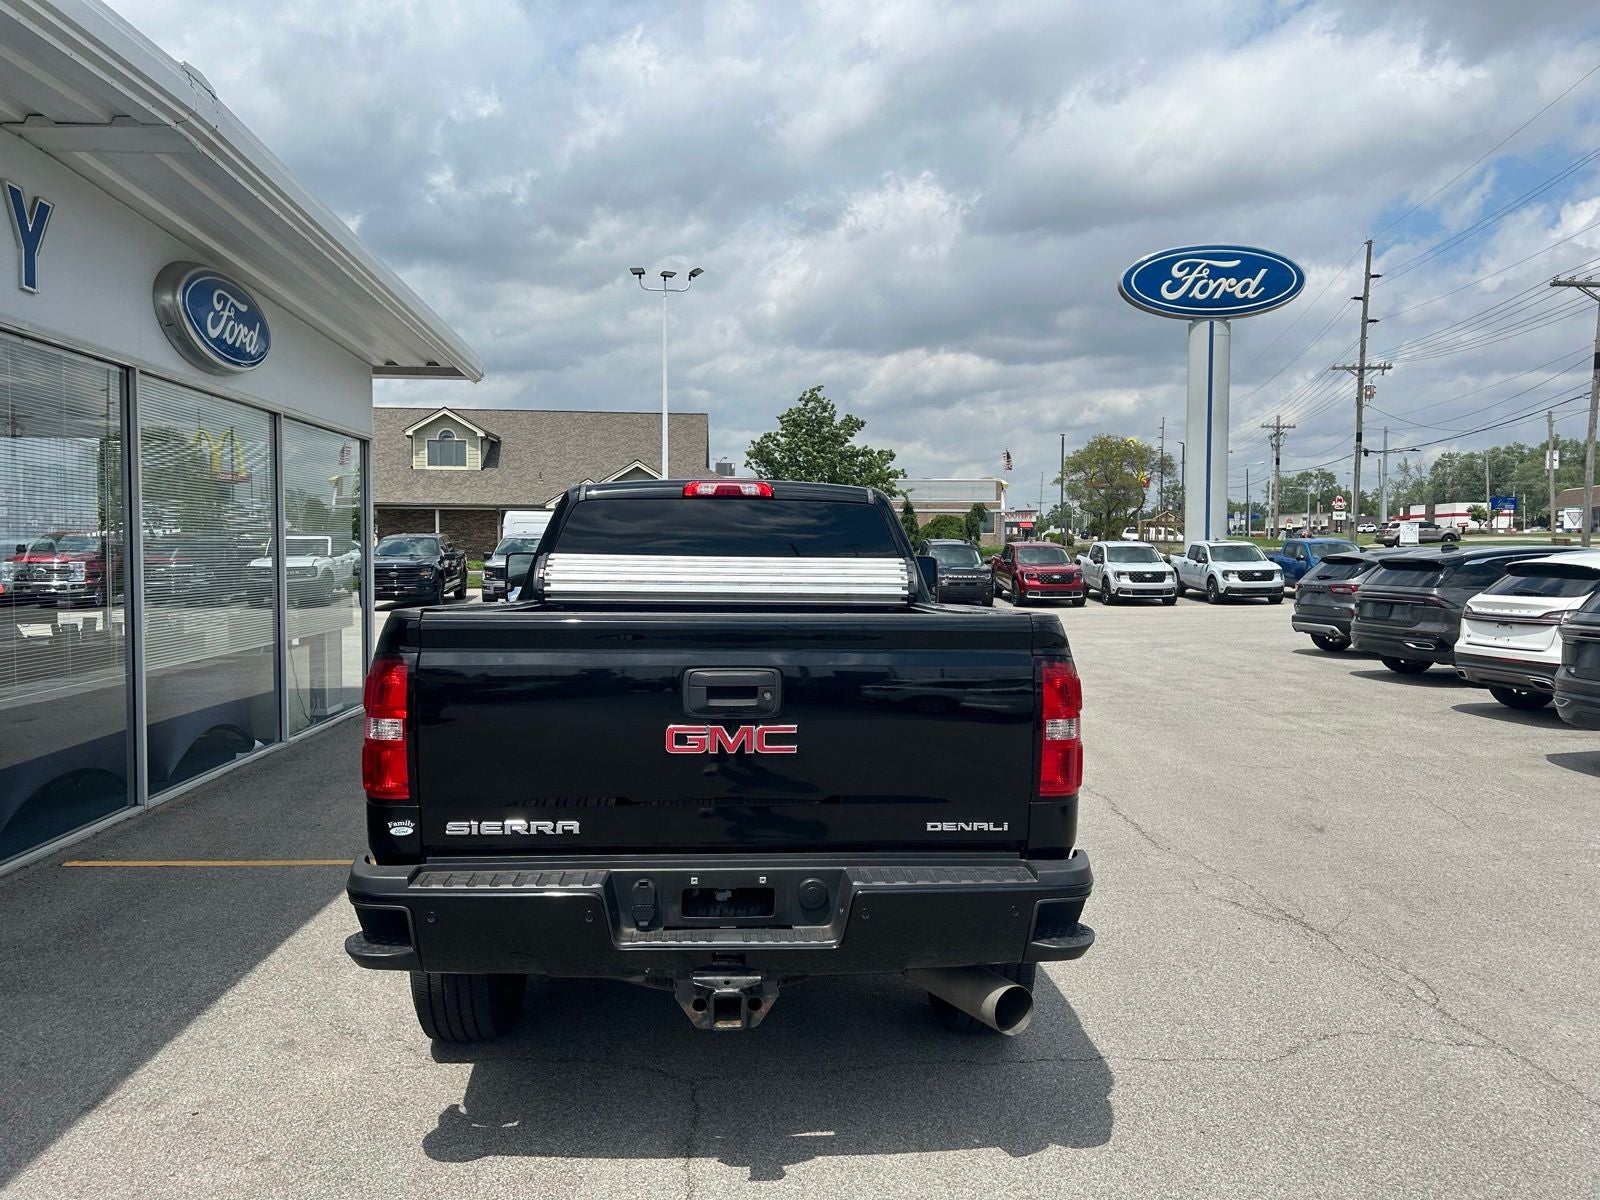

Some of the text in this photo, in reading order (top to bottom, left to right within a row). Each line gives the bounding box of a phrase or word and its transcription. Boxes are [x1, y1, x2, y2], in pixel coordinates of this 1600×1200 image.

[2, 178, 55, 294] Y
[1160, 258, 1268, 300] Ford
[207, 289, 260, 355] Ford
[666, 724, 798, 754] GMC
[387, 819, 416, 828] Family
[445, 819, 580, 835] SIERRA
[926, 822, 1009, 832] DENALI
